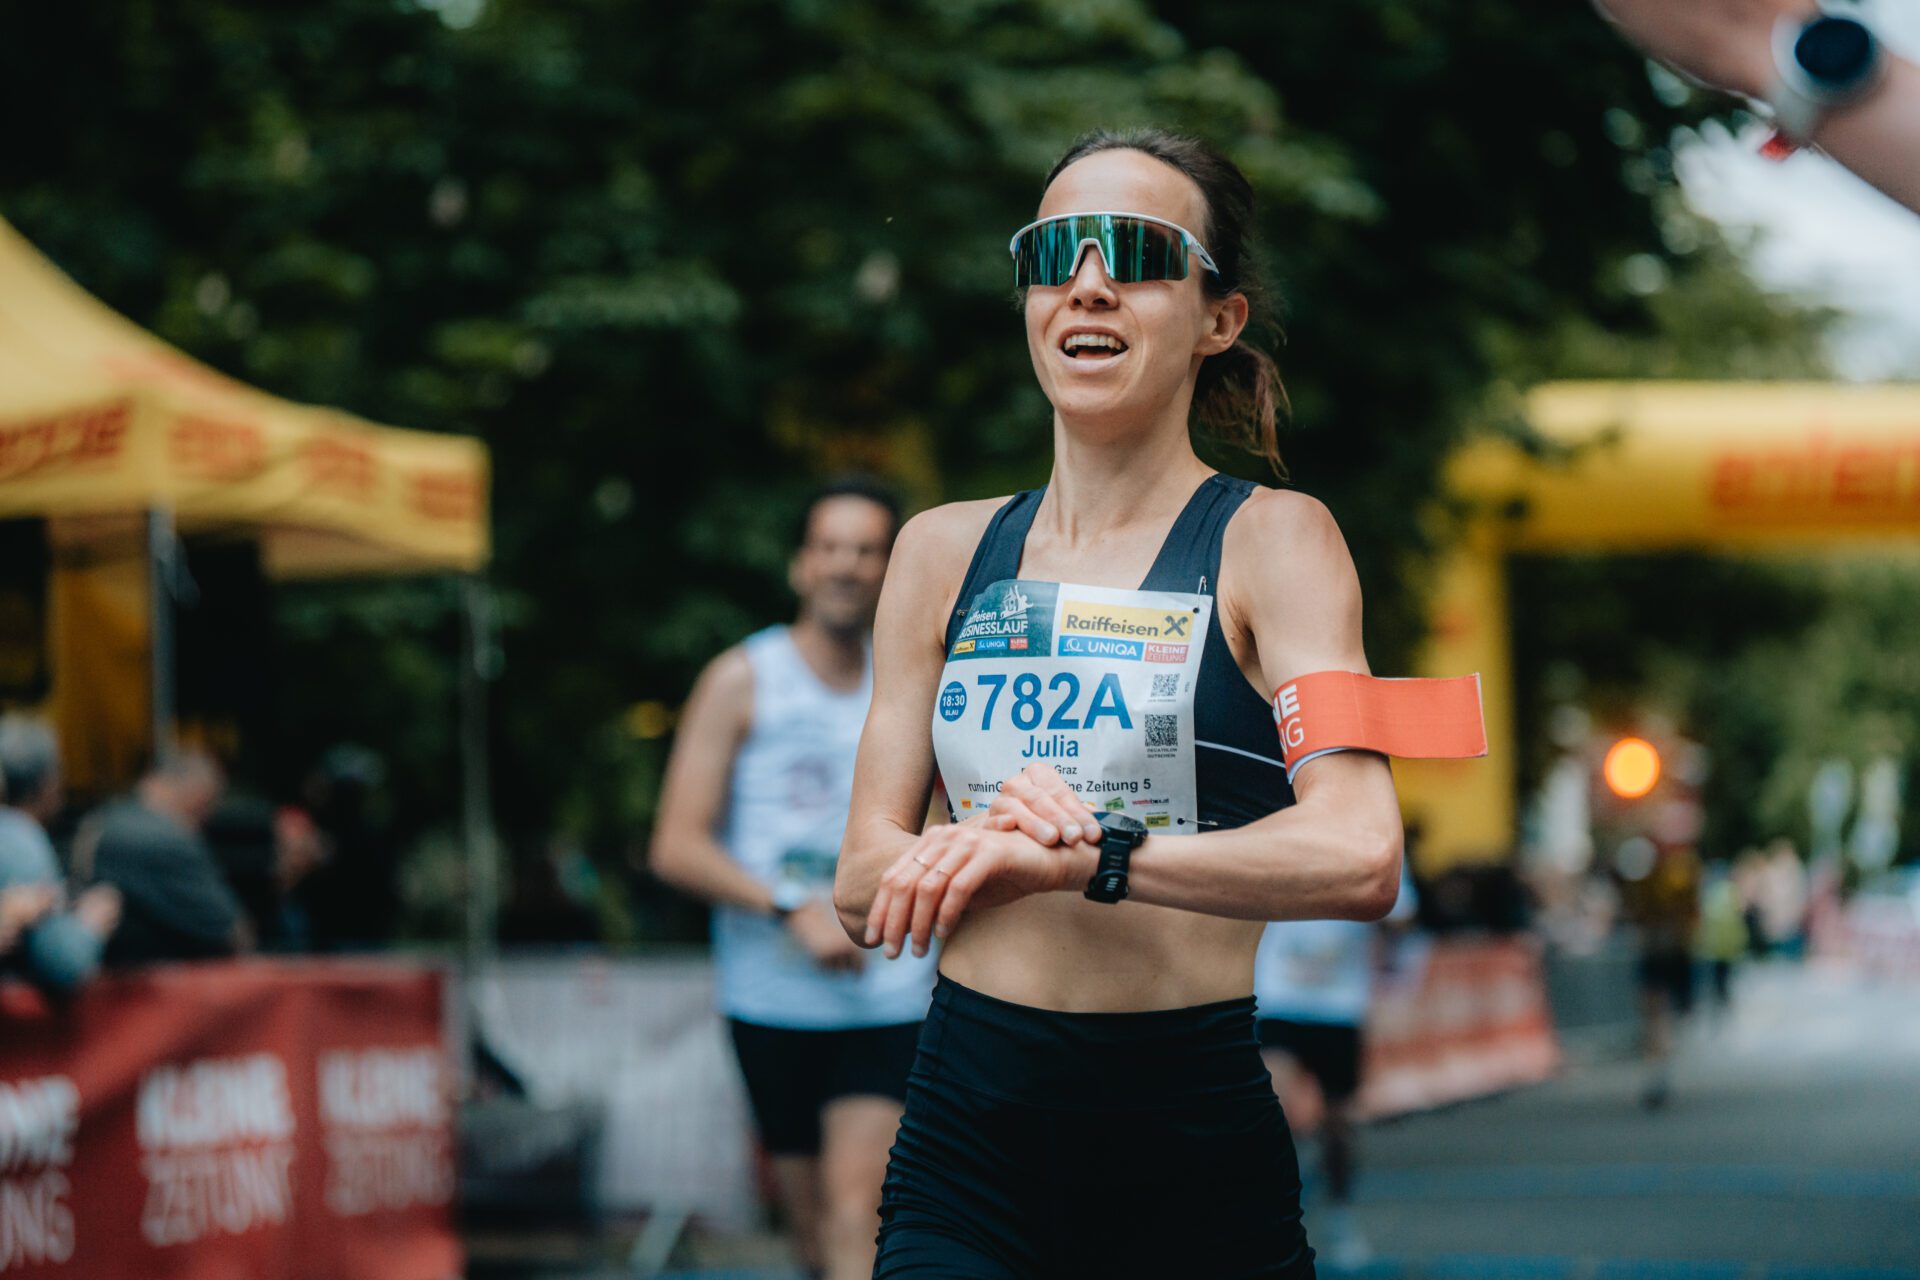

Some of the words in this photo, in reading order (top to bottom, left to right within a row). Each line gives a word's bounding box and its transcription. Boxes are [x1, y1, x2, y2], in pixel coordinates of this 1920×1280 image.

[1066, 614, 1159, 637] Raiffeisen
[1087, 641, 1138, 657] UNIQA
[1148, 645, 1186, 654] KLEINE
[942, 695, 966, 707] 18:30
[977, 672, 1134, 731] 782A
[1021, 735, 1079, 758] Julia
[1086, 780, 1139, 793] Zeitung
[1143, 778, 1152, 789] 5
